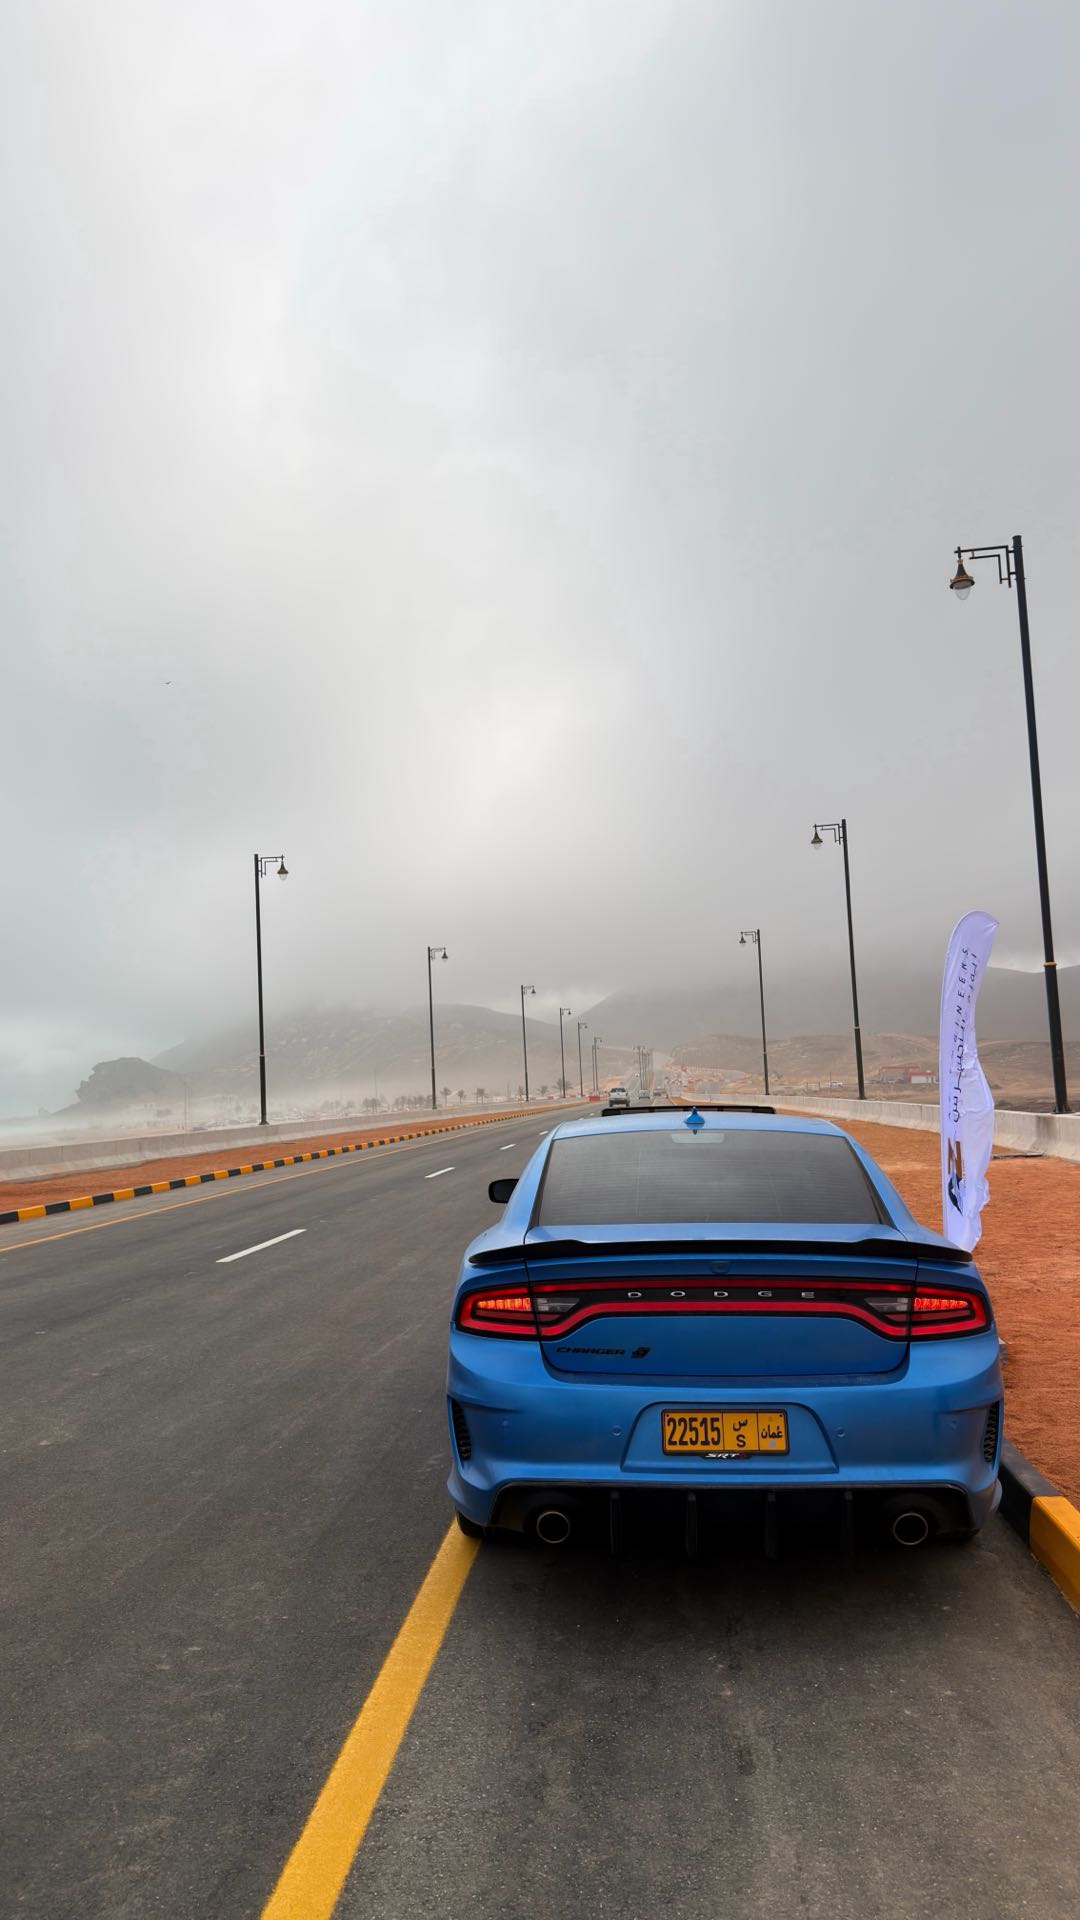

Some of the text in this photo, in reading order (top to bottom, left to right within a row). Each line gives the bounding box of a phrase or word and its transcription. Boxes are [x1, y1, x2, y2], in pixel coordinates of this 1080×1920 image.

[627, 1290, 815, 1299] DODGE
[556, 1347, 625, 1355] CHARGER
[732, 1418, 748, 1431] س
[667, 1417, 721, 1446] 22515
[736, 1434, 746, 1448] S
